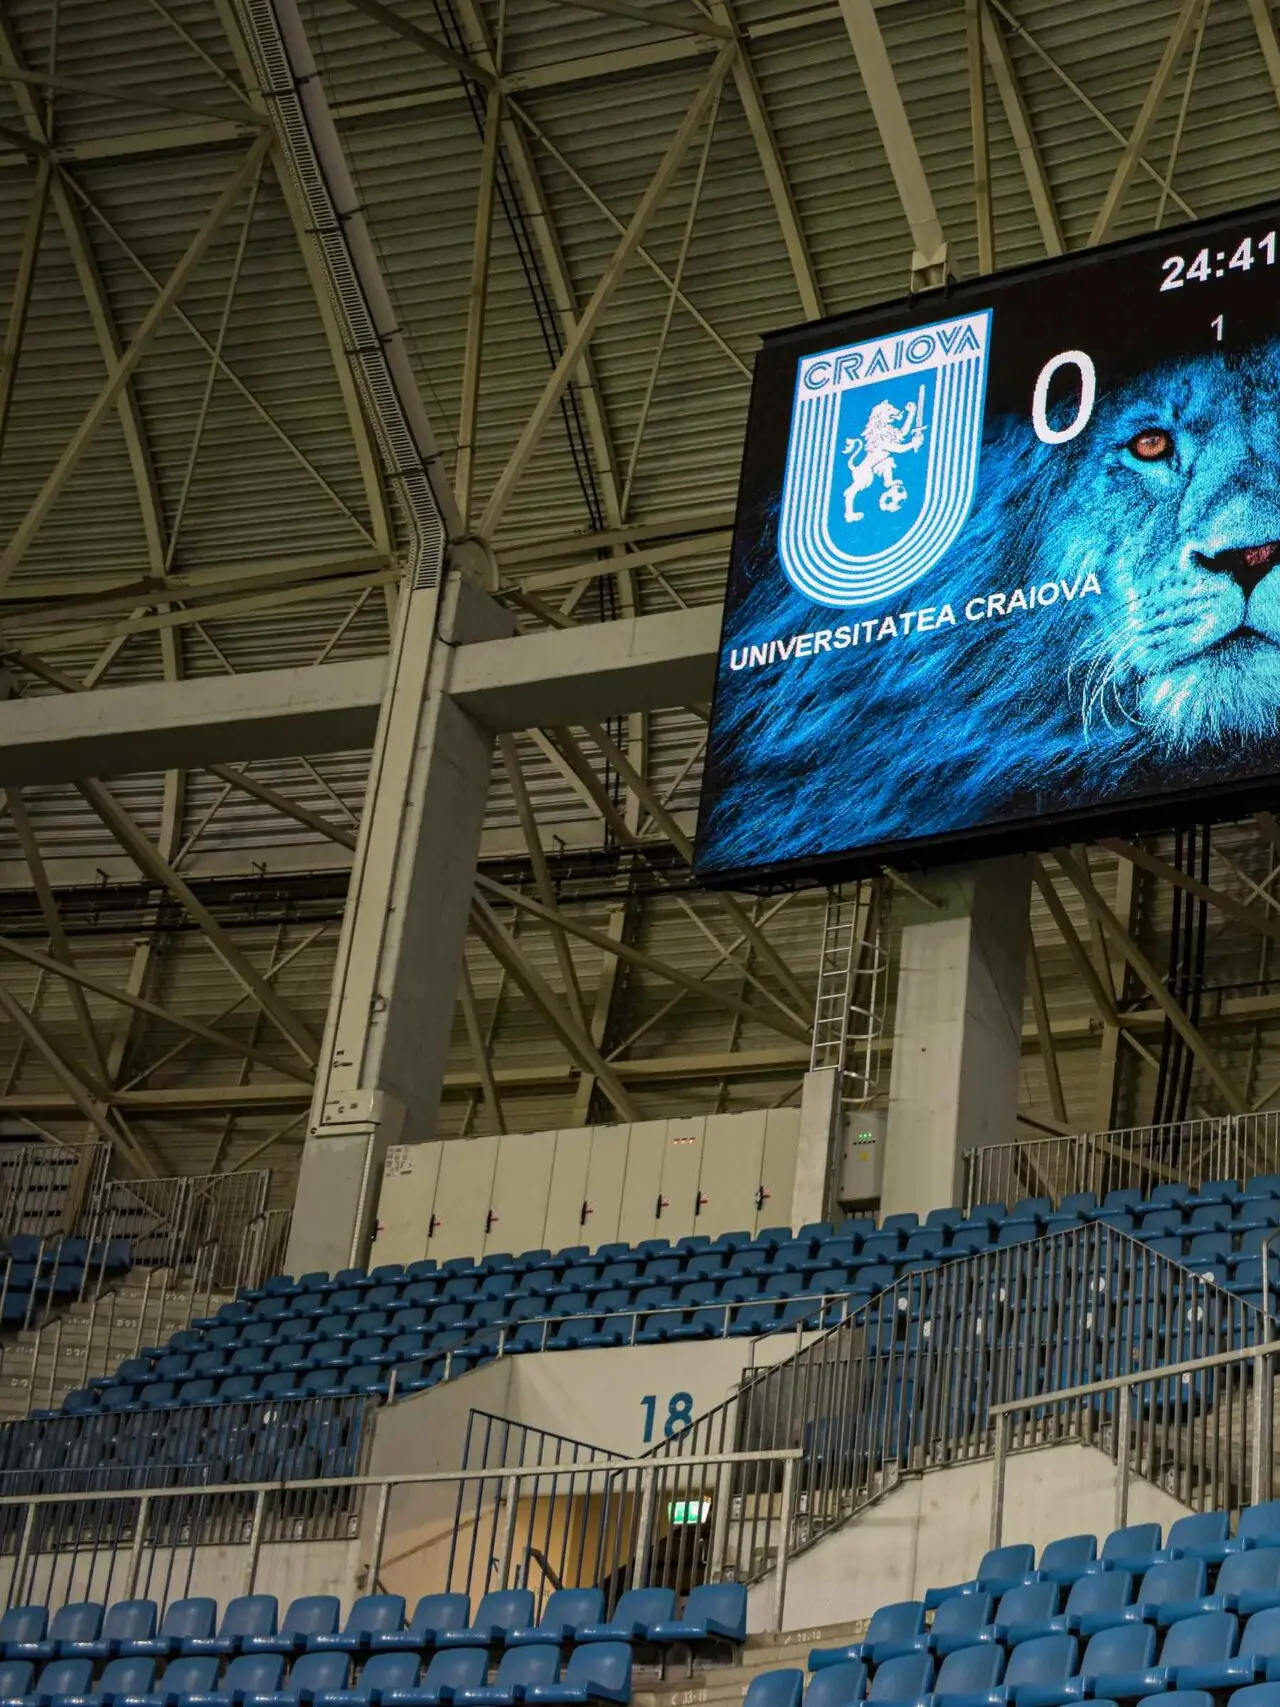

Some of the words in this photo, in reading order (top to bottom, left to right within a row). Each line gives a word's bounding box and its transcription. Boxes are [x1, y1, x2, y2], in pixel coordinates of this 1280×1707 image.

[1159, 231, 1277, 292] 24:41
[803, 323, 982, 391] CRAIOVA
[1210, 313, 1224, 341] 1
[1031, 349, 1096, 444] 0
[729, 605, 957, 672] UNIVERSITATEA
[964, 572, 1103, 622] CRAIOVA
[640, 1391, 694, 1444] 18
